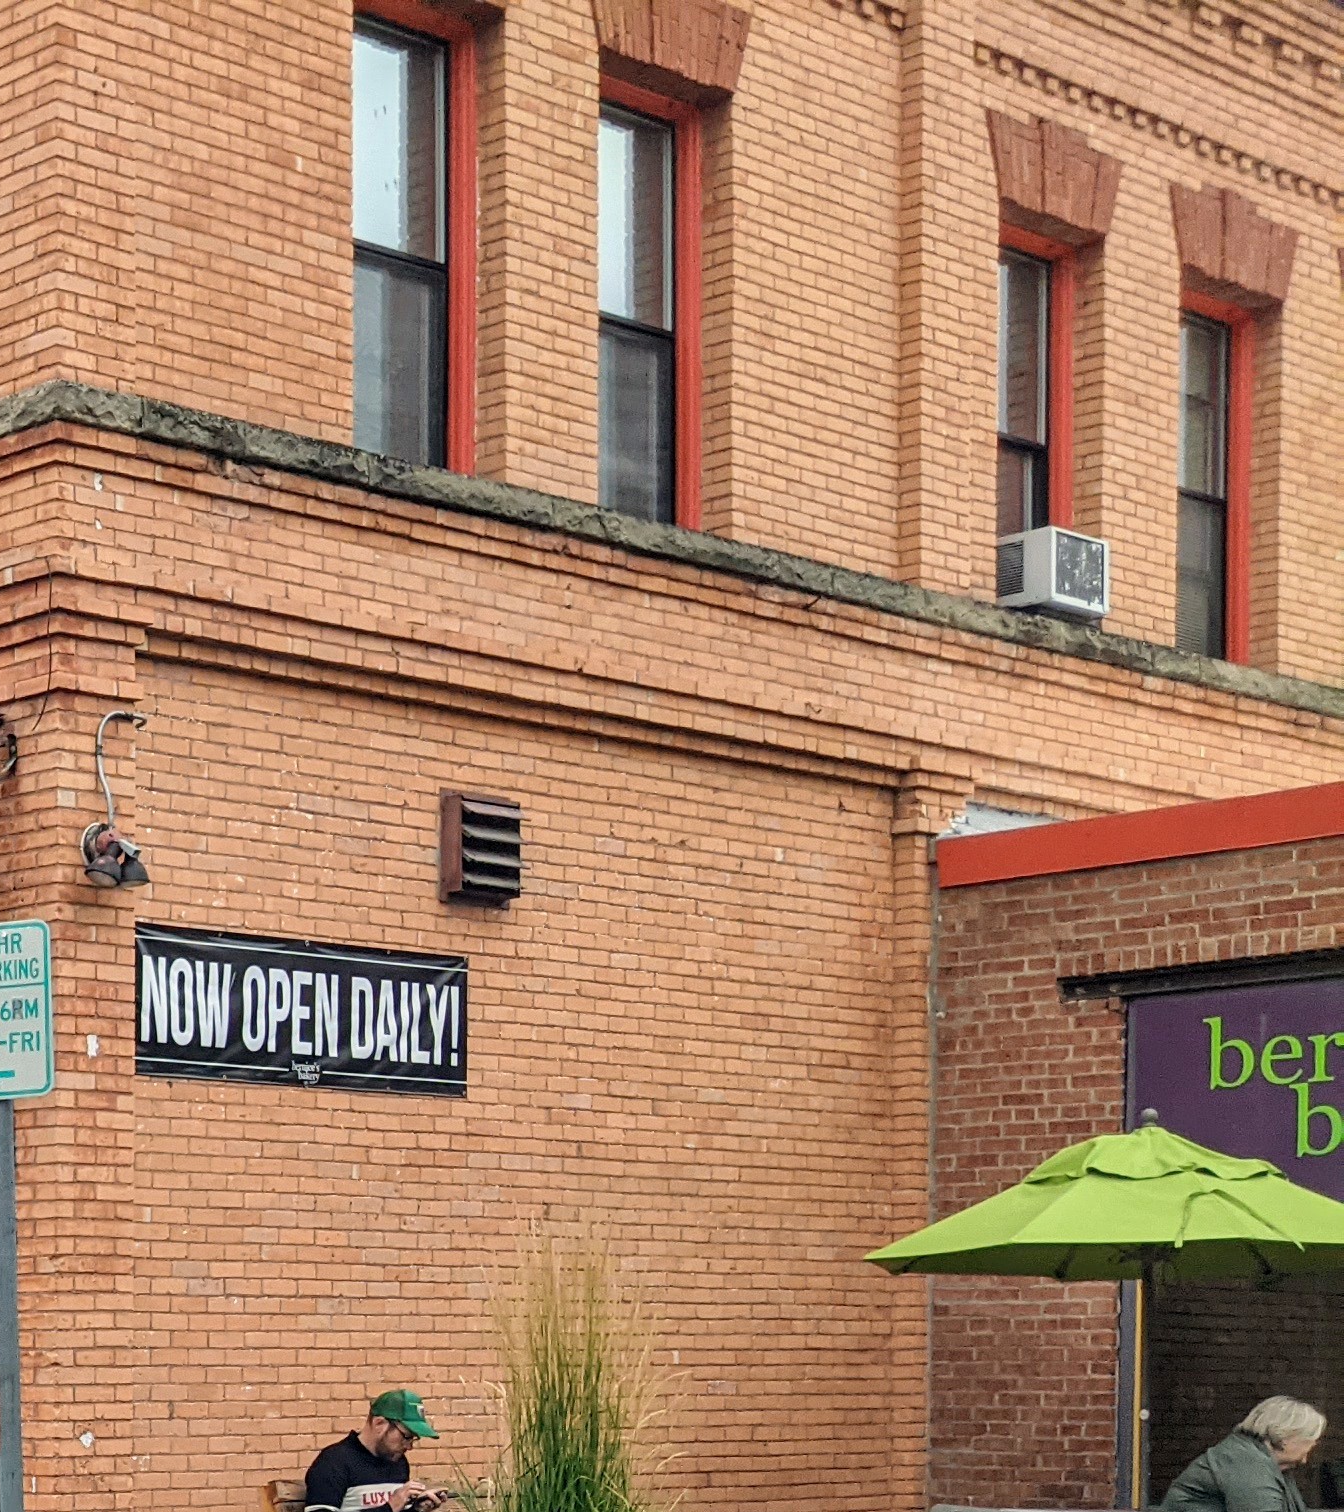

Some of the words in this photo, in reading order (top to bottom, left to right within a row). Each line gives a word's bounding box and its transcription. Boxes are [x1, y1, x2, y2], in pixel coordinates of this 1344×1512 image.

[140, 954, 233, 1049] NOW
[241, 965, 340, 1058] OPEN
[349, 976, 460, 1067] DAILY!
